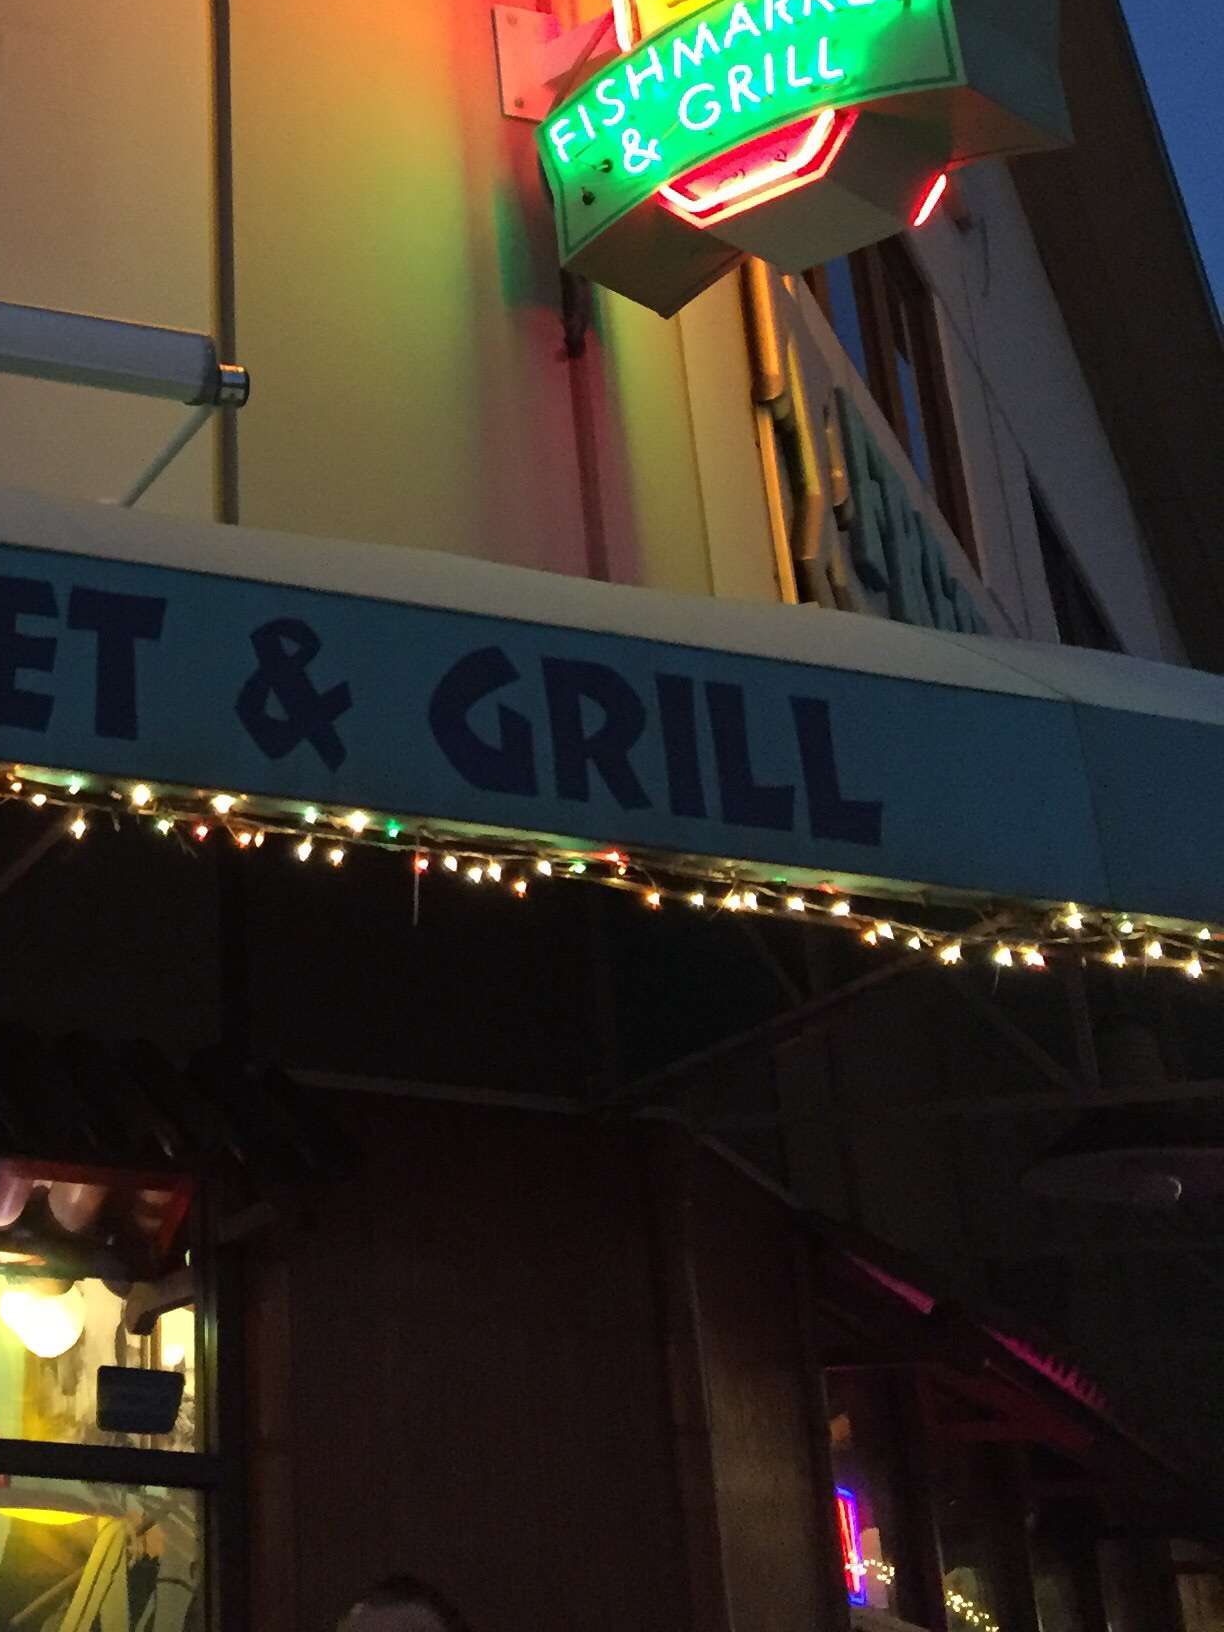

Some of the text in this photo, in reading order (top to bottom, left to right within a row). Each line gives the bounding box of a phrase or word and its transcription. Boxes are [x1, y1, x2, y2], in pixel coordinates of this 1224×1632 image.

[620, 36, 845, 175] & GRILL
[234, 616, 354, 773] &
[427, 644, 885, 848] GRILL
